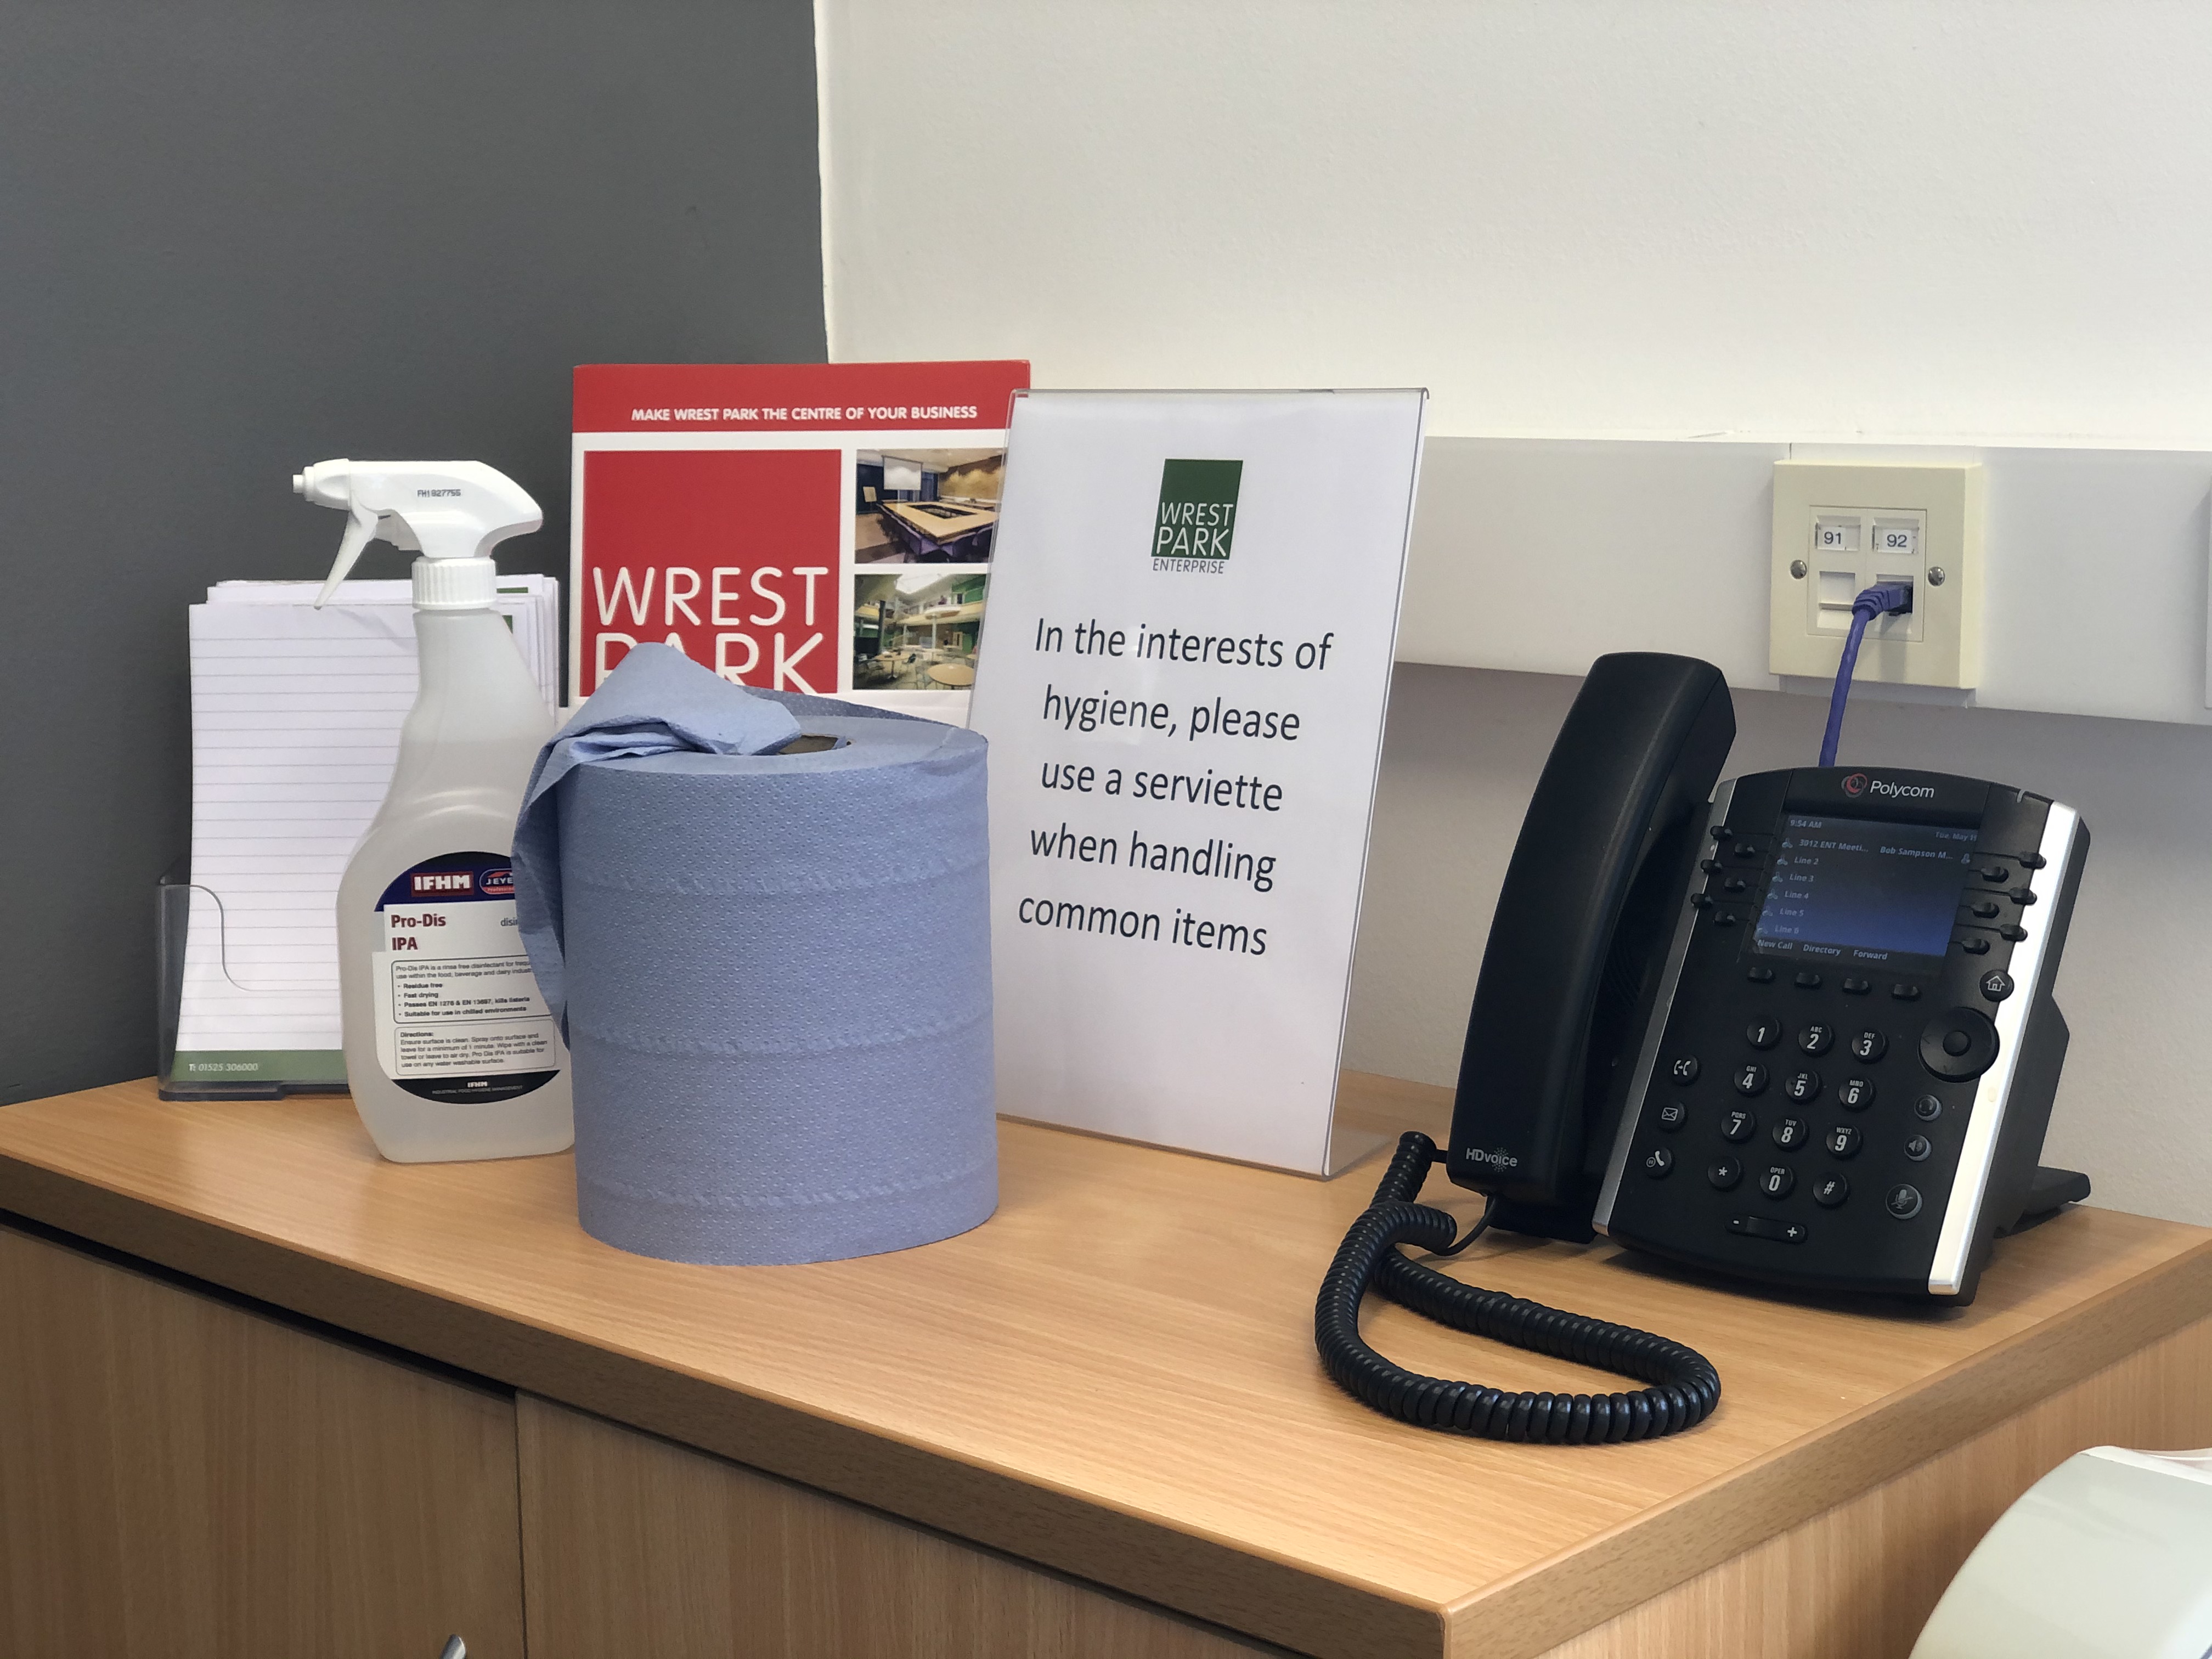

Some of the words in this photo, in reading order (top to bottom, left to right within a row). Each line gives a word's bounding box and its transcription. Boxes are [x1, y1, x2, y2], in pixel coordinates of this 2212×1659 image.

[631, 409, 670, 420] MAKE
[674, 409, 719, 420] WREST
[723, 408, 759, 420] PARK
[761, 408, 787, 420] THE
[792, 408, 841, 420] CENTRE
[845, 407, 864, 419] OF
[868, 407, 907, 419] YOUR
[911, 406, 977, 419] BUSINESS
[1162, 502, 1233, 526] WREST
[1156, 527, 1229, 556] PARK
[1824, 532, 1842, 545] 91
[1887, 534, 1907, 548] 92
[1153, 558, 1224, 574] ENTERPRISE
[592, 567, 830, 626] WREST
[1035, 618, 1063, 652] In
[1075, 619, 1125, 657] the
[1136, 623, 1284, 667] interests
[1295, 633, 1334, 670] of
[1043, 684, 1177, 737] hygiene,
[1190, 697, 1300, 741] please
[1042, 763, 1094, 792] use
[1105, 769, 1121, 795] a
[1133, 769, 1283, 811] serviette
[1870, 780, 1934, 798] Polycom
[1799, 839, 1818, 848] 3012
[1898, 848, 1935, 858] Sampson
[1031, 822, 1117, 865] when
[1129, 831, 1276, 893] handling
[414, 874, 471, 890] IFHM
[391, 913, 446, 928] Pro-Dis
[501, 917, 518, 926] disi
[1019, 898, 1159, 941] common
[1172, 909, 1267, 955] items
[1775, 925, 1792, 933] Line
[392, 937, 418, 950] IPA
[1758, 939, 1775, 948] New
[1778, 941, 1793, 950] Call
[1803, 944, 1841, 956] Directory
[1853, 950, 1888, 960] Forward
[1757, 1027, 1765, 1042] 1
[1807, 1034, 1819, 1049] 2
[1860, 1040, 1872, 1056] 3
[1742, 1074, 1753, 1088] 4
[1795, 1080, 1806, 1096] 5
[1848, 1088, 1859, 1103] 6
[1730, 1119, 1741, 1135] 7
[1781, 1127, 1793, 1143] 8
[1835, 1135, 1847, 1151] 9
[1769, 1175, 1780, 1191] 0
